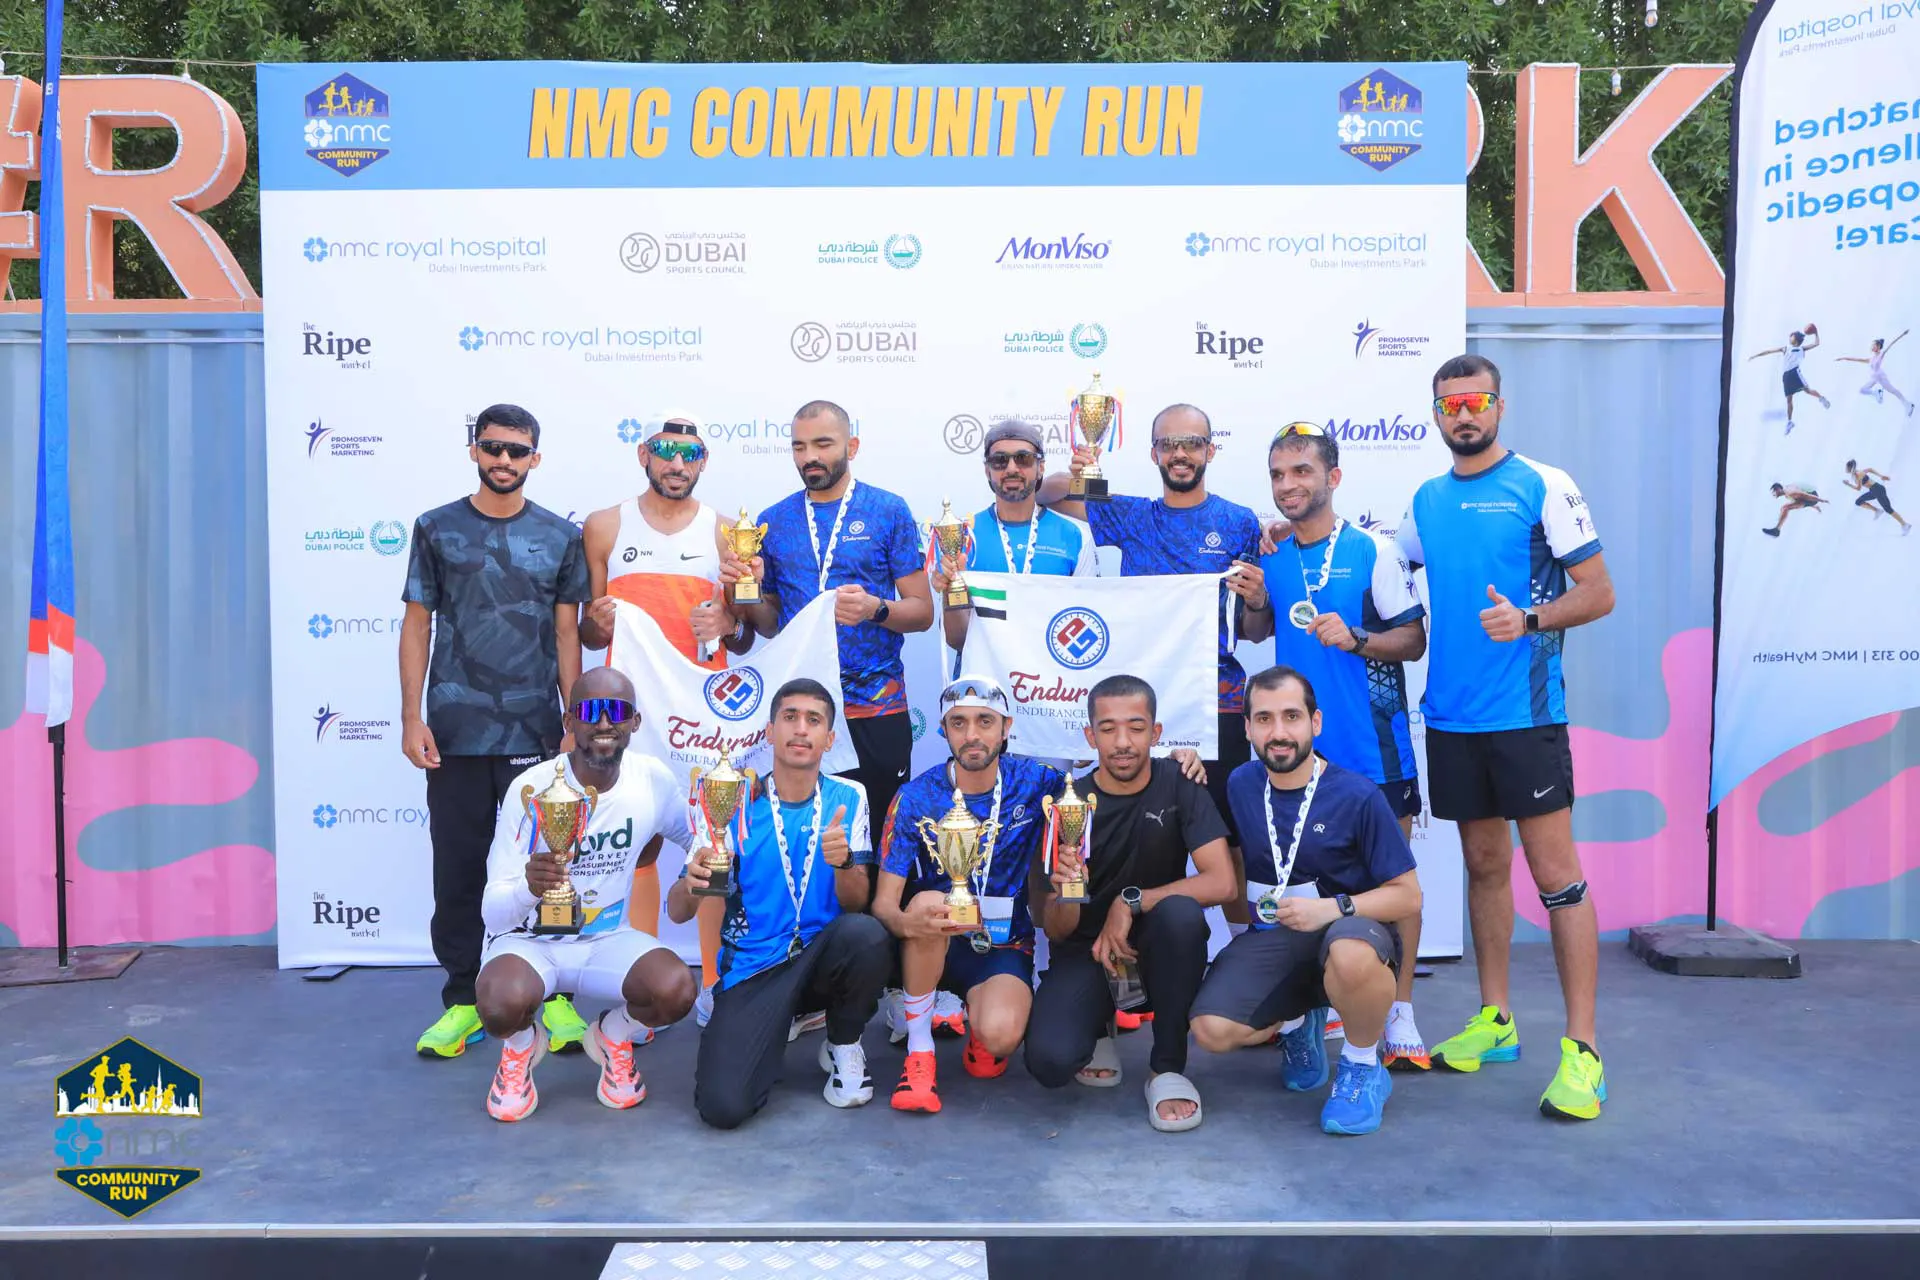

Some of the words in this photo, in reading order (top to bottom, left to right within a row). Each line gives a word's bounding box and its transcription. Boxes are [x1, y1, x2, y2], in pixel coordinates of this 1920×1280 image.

[528, 87, 671, 158] NMC
[690, 86, 1066, 158] COMMUNITY
[1081, 85, 1203, 157] RUN
[1367, 119, 1424, 137] nmc
[334, 124, 391, 143] nmc
[317, 150, 378, 160] COMMUNITY
[1350, 145, 1411, 155] COMMUNITY
[1369, 153, 1392, 162] RUN
[336, 159, 360, 168] RUN
[329, 241, 379, 257] nmc
[386, 237, 443, 261] royal
[451, 236, 547, 260] hospital
[665, 242, 746, 262] DUBAI
[818, 243, 844, 256] دبي
[845, 240, 879, 256] شرطة
[1211, 237, 1261, 253] nmc
[1268, 233, 1324, 257] royal
[1332, 232, 1427, 256] hospital
[428, 262, 457, 273] Dubai
[459, 262, 521, 273] Investments
[523, 261, 547, 273] Park
[818, 256, 845, 265] DUBAI
[847, 256, 878, 264] POLICE
[1310, 258, 1338, 269] Dubai
[1341, 258, 1400, 269] Investments
[1403, 257, 1427, 268] Park
[666, 266, 703, 274] SPORTS
[705, 266, 746, 274] COUNCIL
[485, 329, 535, 346] nmc
[542, 327, 599, 351] royal
[607, 326, 702, 350] hospital
[836, 332, 917, 351] DUBAI
[1004, 332, 1030, 344] دبي
[1031, 329, 1064, 344] شرطة
[302, 331, 371, 361] Ripe
[1004, 345, 1031, 353] DUBAI
[1033, 345, 1064, 353] POLICE
[1195, 331, 1264, 360] Ripe
[584, 351, 613, 362] Dubai
[615, 351, 677, 362] Investments
[679, 351, 702, 361] Park
[836, 355, 874, 363] SPORTS
[876, 355, 916, 363] COUNCIL
[705, 419, 757, 441] oyal
[742, 444, 771, 454] Dubai
[305, 529, 331, 542] دبي
[331, 526, 365, 542] شرطة
[305, 543, 332, 551] DUBAI
[334, 618, 384, 633] nmc
[1009, 671, 1089, 703] Endur
[1016, 706, 1088, 719] ENDURANCE
[668, 715, 767, 753] Enduran
[1157, 740, 1201, 748] ce_bikeshop
[670, 751, 741, 766] ENDURACE
[338, 808, 388, 824] nmc
[395, 808, 430, 828] roy
[313, 900, 381, 930] Ripe
